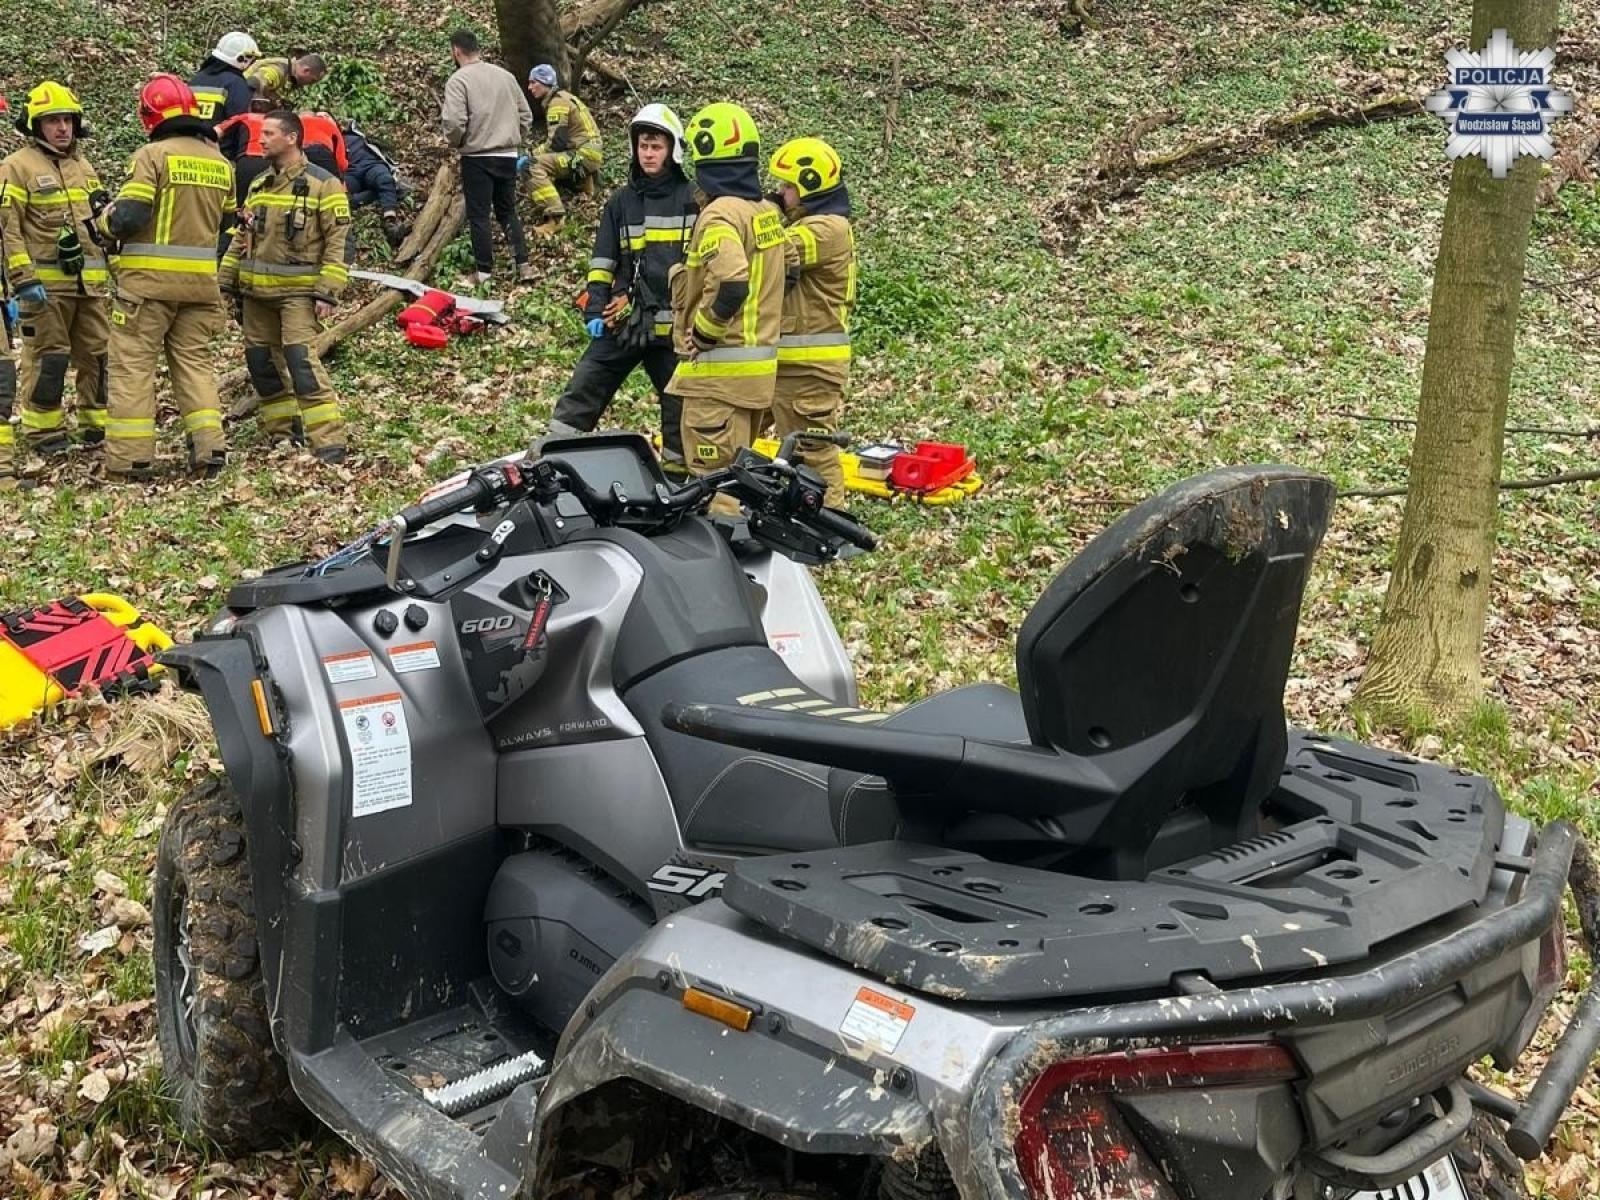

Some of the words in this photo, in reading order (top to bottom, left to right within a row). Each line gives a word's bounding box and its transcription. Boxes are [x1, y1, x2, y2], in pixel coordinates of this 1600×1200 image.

[461, 615, 514, 633] 600
[500, 727, 552, 747] ALWAYS
[559, 718, 608, 731] FORWARD
